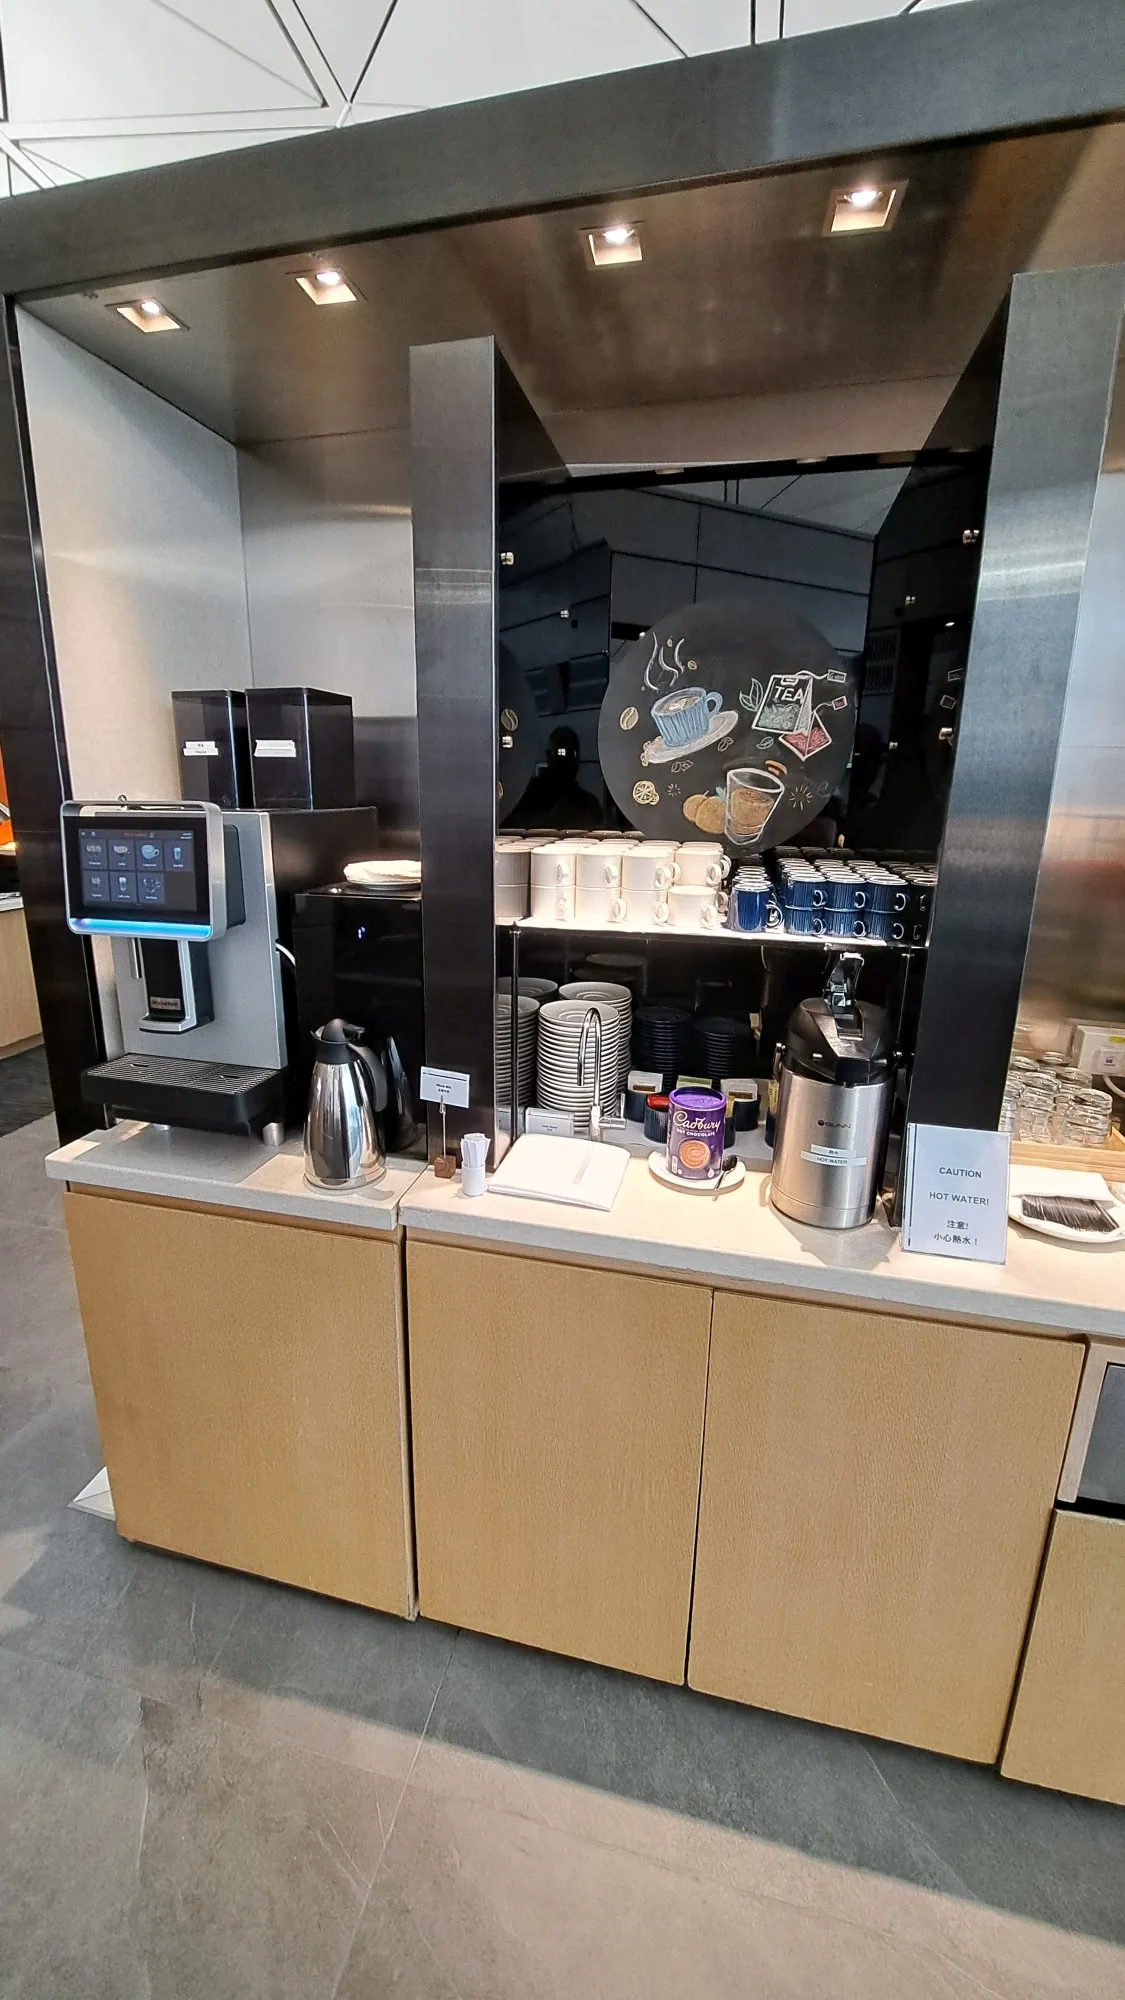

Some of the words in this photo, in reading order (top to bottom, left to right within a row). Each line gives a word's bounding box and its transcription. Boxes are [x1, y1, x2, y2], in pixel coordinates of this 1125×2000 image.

[774, 686, 804, 703] TEA
[673, 1111, 720, 1132] Cadbury
[939, 1166, 982, 1179] CAUTION
[929, 1191, 949, 1201] HOT
[951, 1194, 989, 1206] WATER!
[946, 1219, 969, 1231] 注意!
